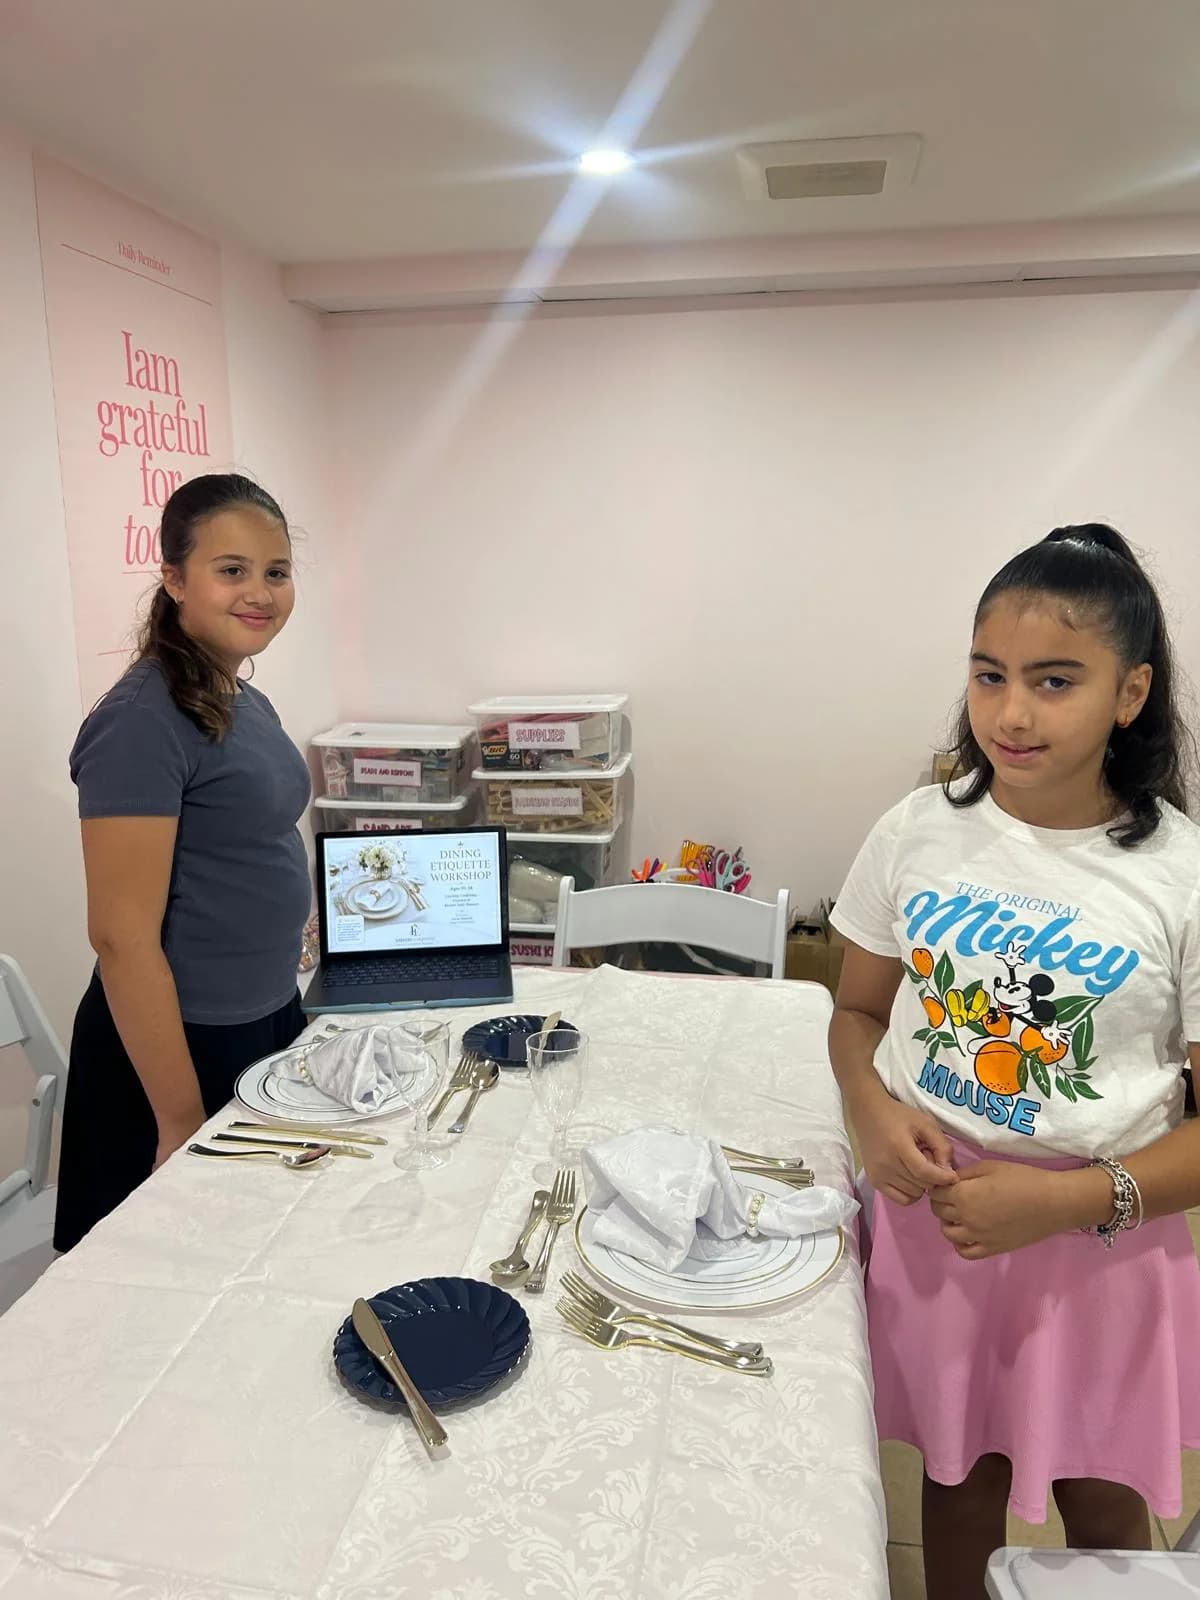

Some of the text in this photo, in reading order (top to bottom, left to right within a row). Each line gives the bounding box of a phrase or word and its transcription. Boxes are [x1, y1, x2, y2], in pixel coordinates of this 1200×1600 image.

[97, 399, 211, 457] grateful
[515, 728, 566, 743] SUPPLIES
[440, 849, 481, 859] DINING
[430, 860, 492, 871] ETIQUETTE
[430, 871, 492, 881] WORKSHOP
[957, 881, 1083, 921] THE ORIGINAL
[511, 944, 542, 956] SUSHI
[903, 890, 1140, 996] Mickey
[917, 1056, 1041, 1136] MOUSE
